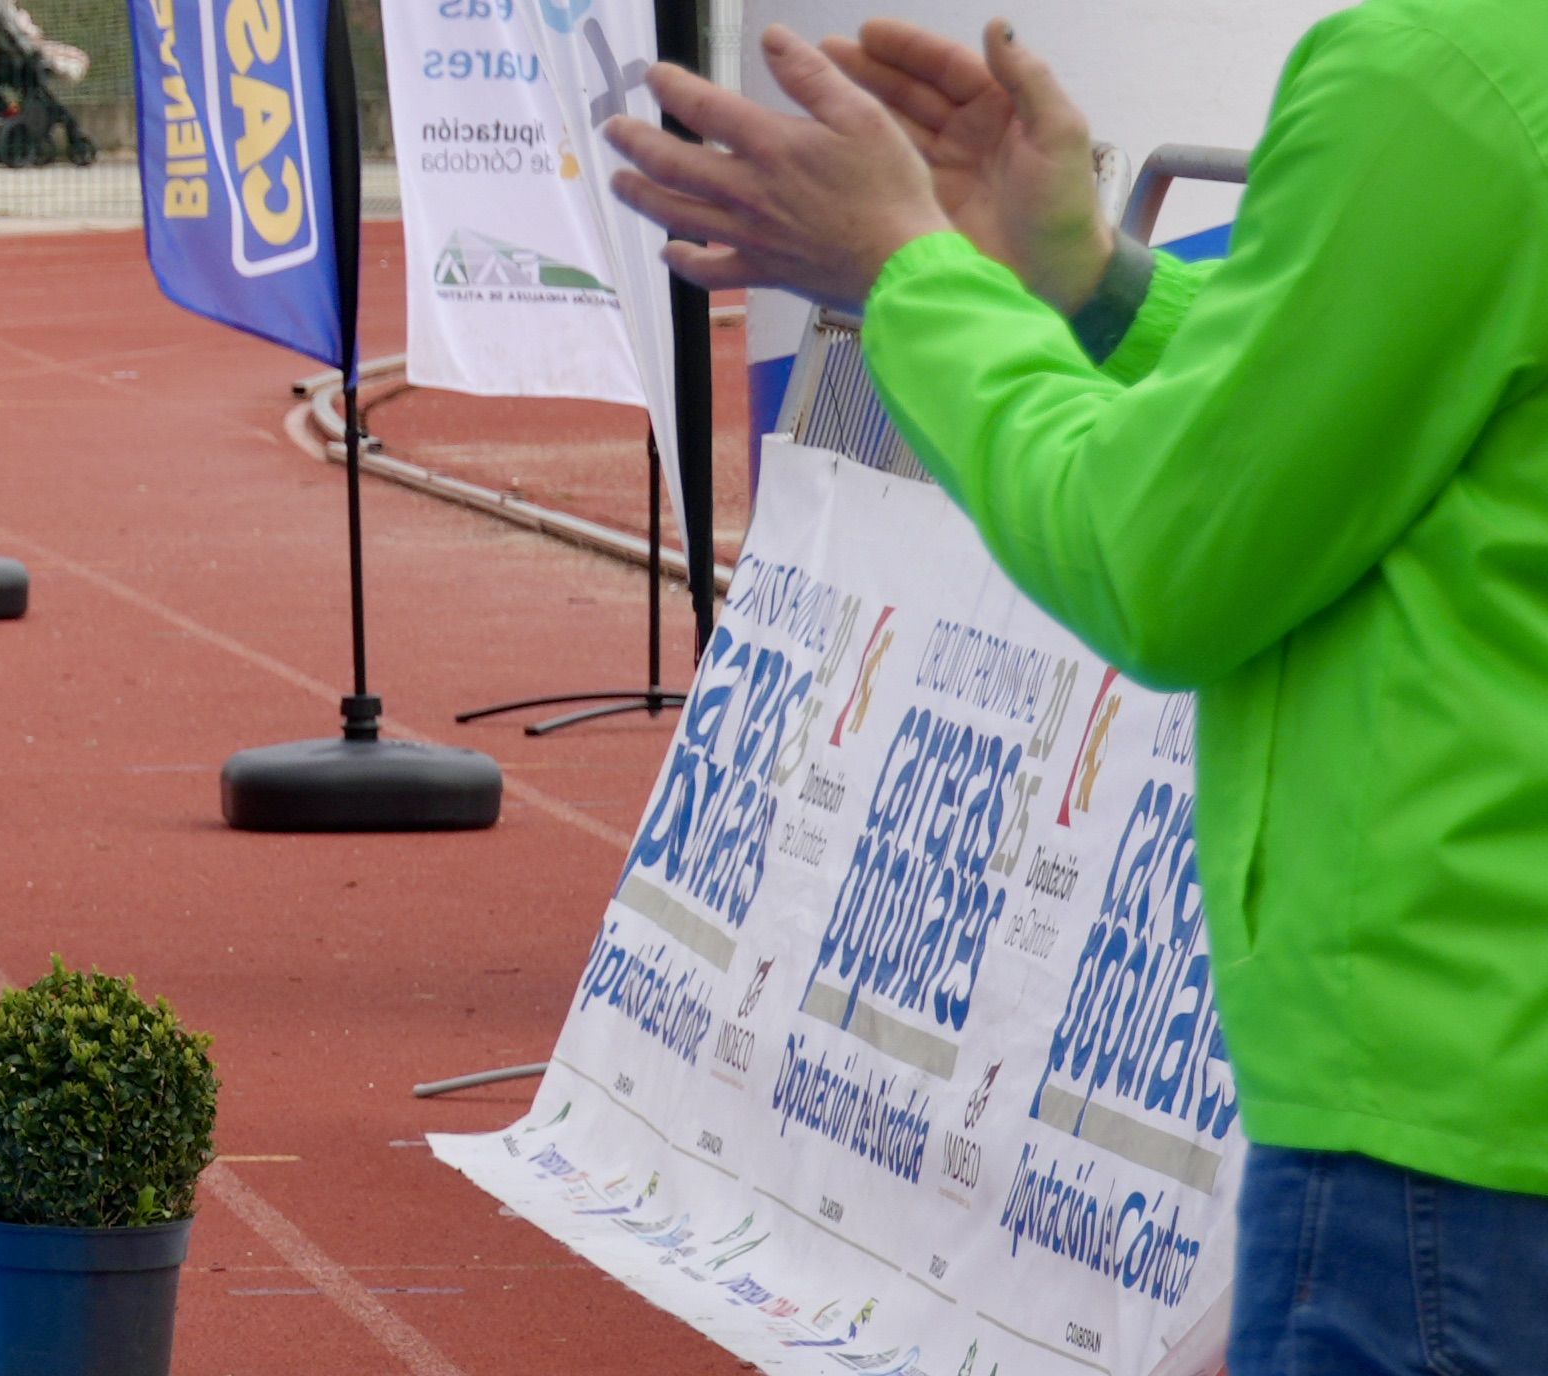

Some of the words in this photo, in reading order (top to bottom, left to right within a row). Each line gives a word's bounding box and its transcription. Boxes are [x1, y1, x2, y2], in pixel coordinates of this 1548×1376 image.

[1027, 657, 1079, 763] 20
[865, 705, 1023, 881] carreras
[989, 770, 1044, 878] 25
[1025, 845, 1079, 903] Diputación
[799, 835, 1007, 1032] populares
[772, 1031, 860, 1147] Diputación
[1000, 1142, 1101, 1272] Diputación
